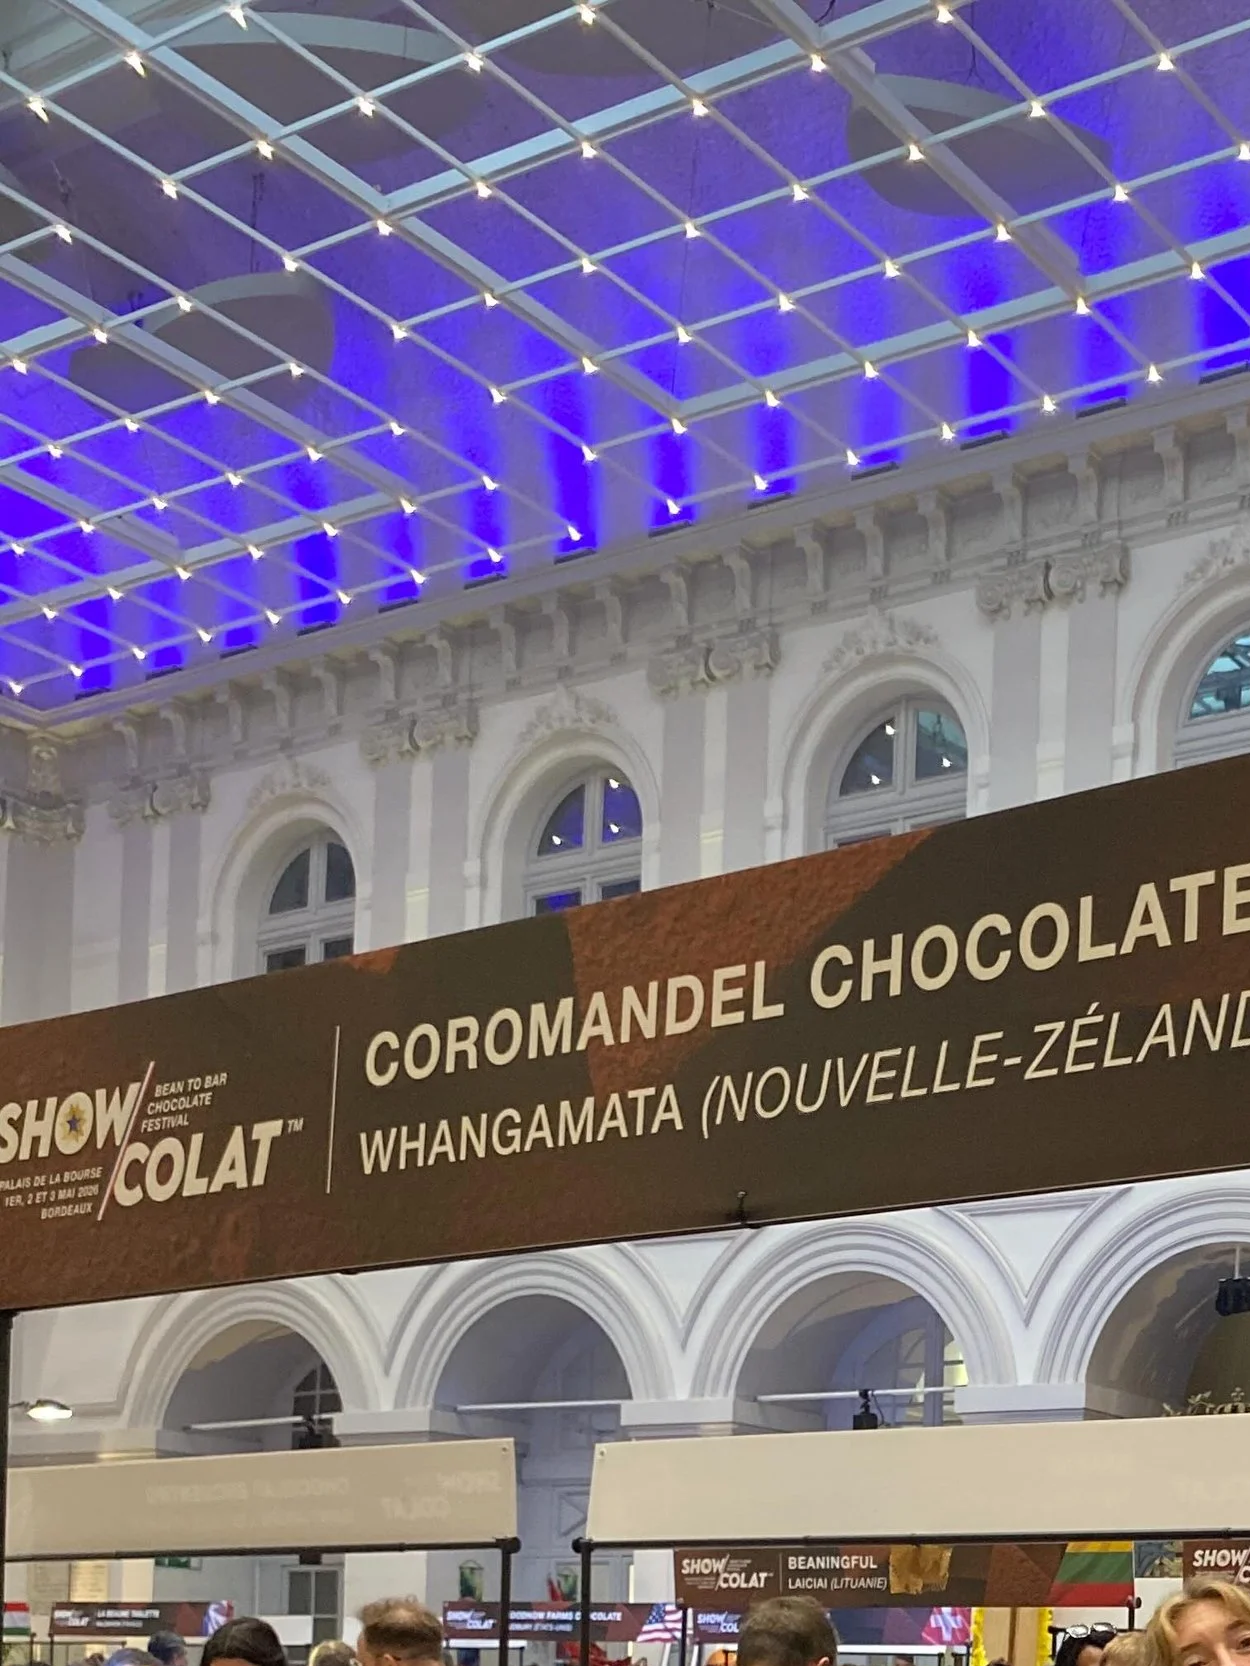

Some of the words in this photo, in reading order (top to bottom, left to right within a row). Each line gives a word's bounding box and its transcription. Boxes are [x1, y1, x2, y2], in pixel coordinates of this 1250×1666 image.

[365, 960, 785, 1087] COROMANDEL
[155, 1081, 184, 1098] BEAN
[187, 1077, 202, 1092] TO
[204, 1072, 228, 1089] BAR
[147, 1092, 213, 1115] CHOCOLATE
[0, 1082, 141, 1164] SHOW
[141, 1113, 190, 1134] FESTIVAL
[359, 1084, 684, 1175] WHANGAMATA
[33, 1175, 46, 1187] DE
[49, 1172, 61, 1184] LA
[63, 1167, 104, 1183] BOURSE
[27, 1193, 34, 1206] 2
[35, 1190, 48, 1204] ET
[50, 1189, 56, 1201] 3
[58, 1187, 76, 1200] MAI
[40, 1203, 94, 1220] BORDEAUX
[681, 1557, 726, 1575] SHOW
[788, 1556, 878, 1570] BEANINGFUL
[1193, 1549, 1249, 1568] SHOW
[788, 1577, 828, 1589] LAICIAI
[831, 1576, 888, 1591] (LITUANIE)
[719, 1622, 739, 1633] COL
